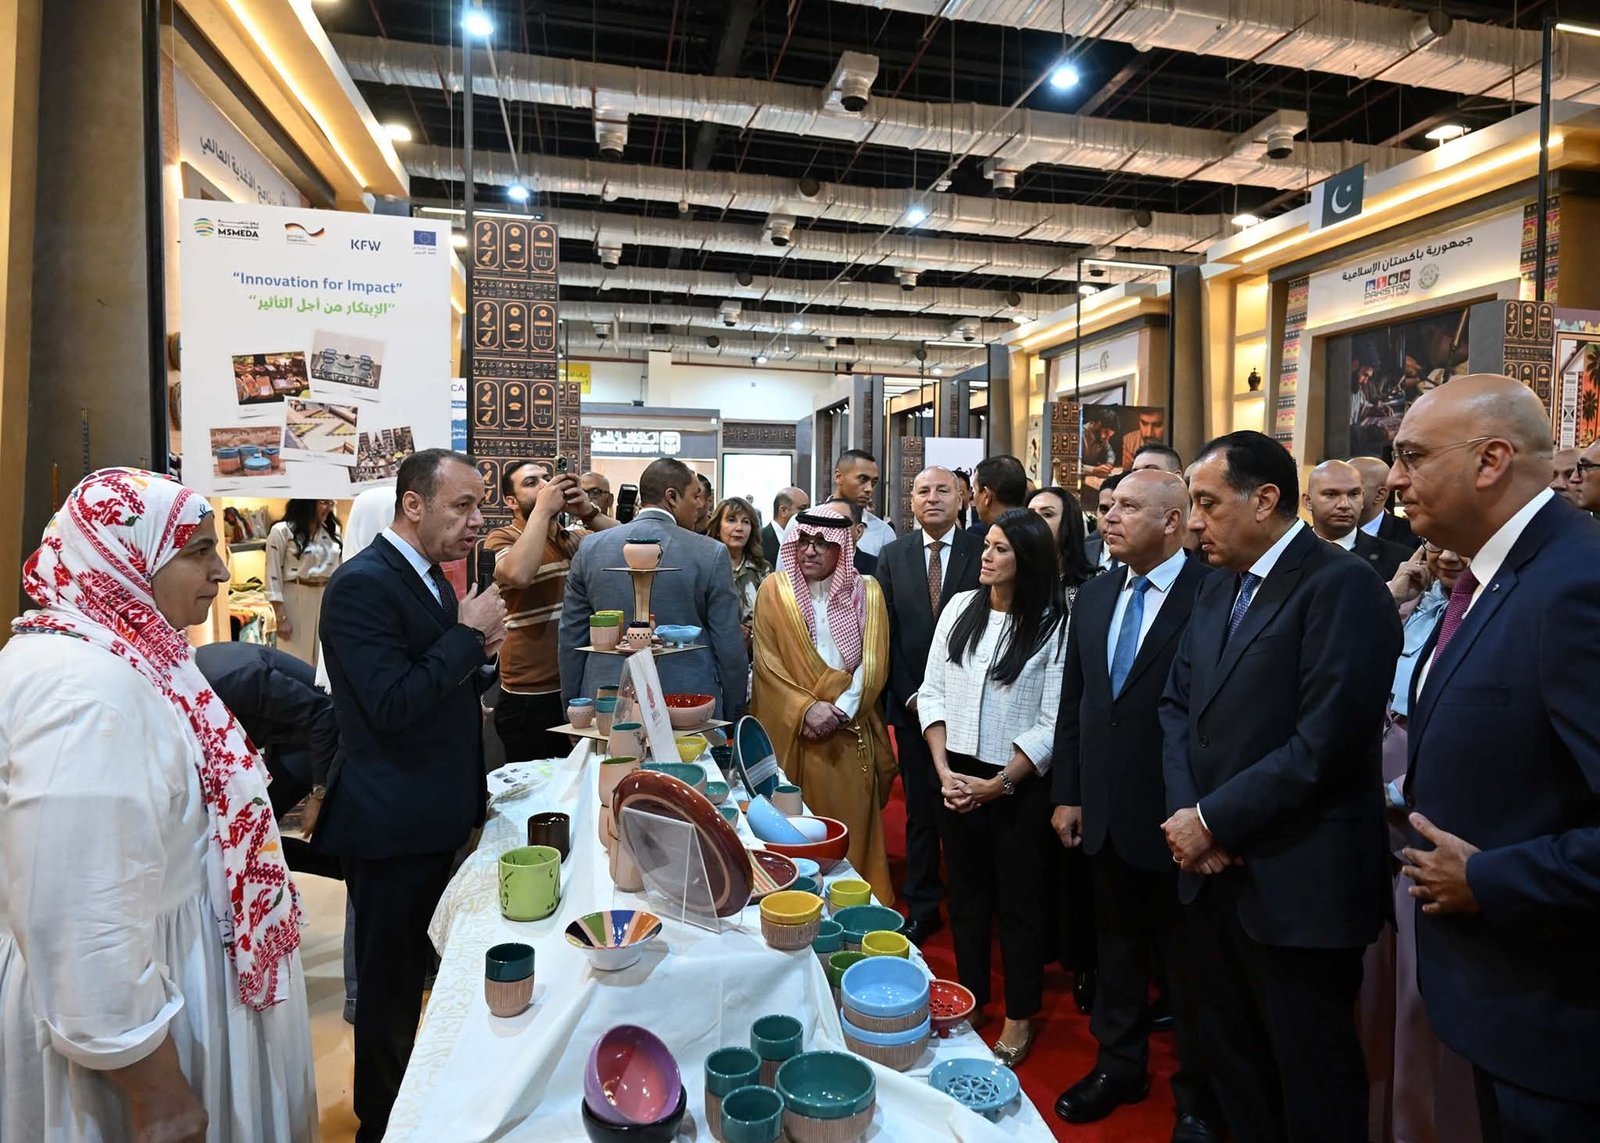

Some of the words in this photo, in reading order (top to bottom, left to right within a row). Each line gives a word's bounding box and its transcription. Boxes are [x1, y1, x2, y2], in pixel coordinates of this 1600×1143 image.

[218, 227, 259, 238] MSMEDA
[351, 239, 381, 251] KFW
[1426, 236, 1473, 257] جمهورية
[1381, 248, 1424, 272] باكستان
[1342, 261, 1381, 282] الإسلامية
[323, 278, 343, 290] for
[1364, 282, 1410, 300] PAKISTAN
[296, 297, 320, 313] أجل
[324, 302, 343, 314] من
